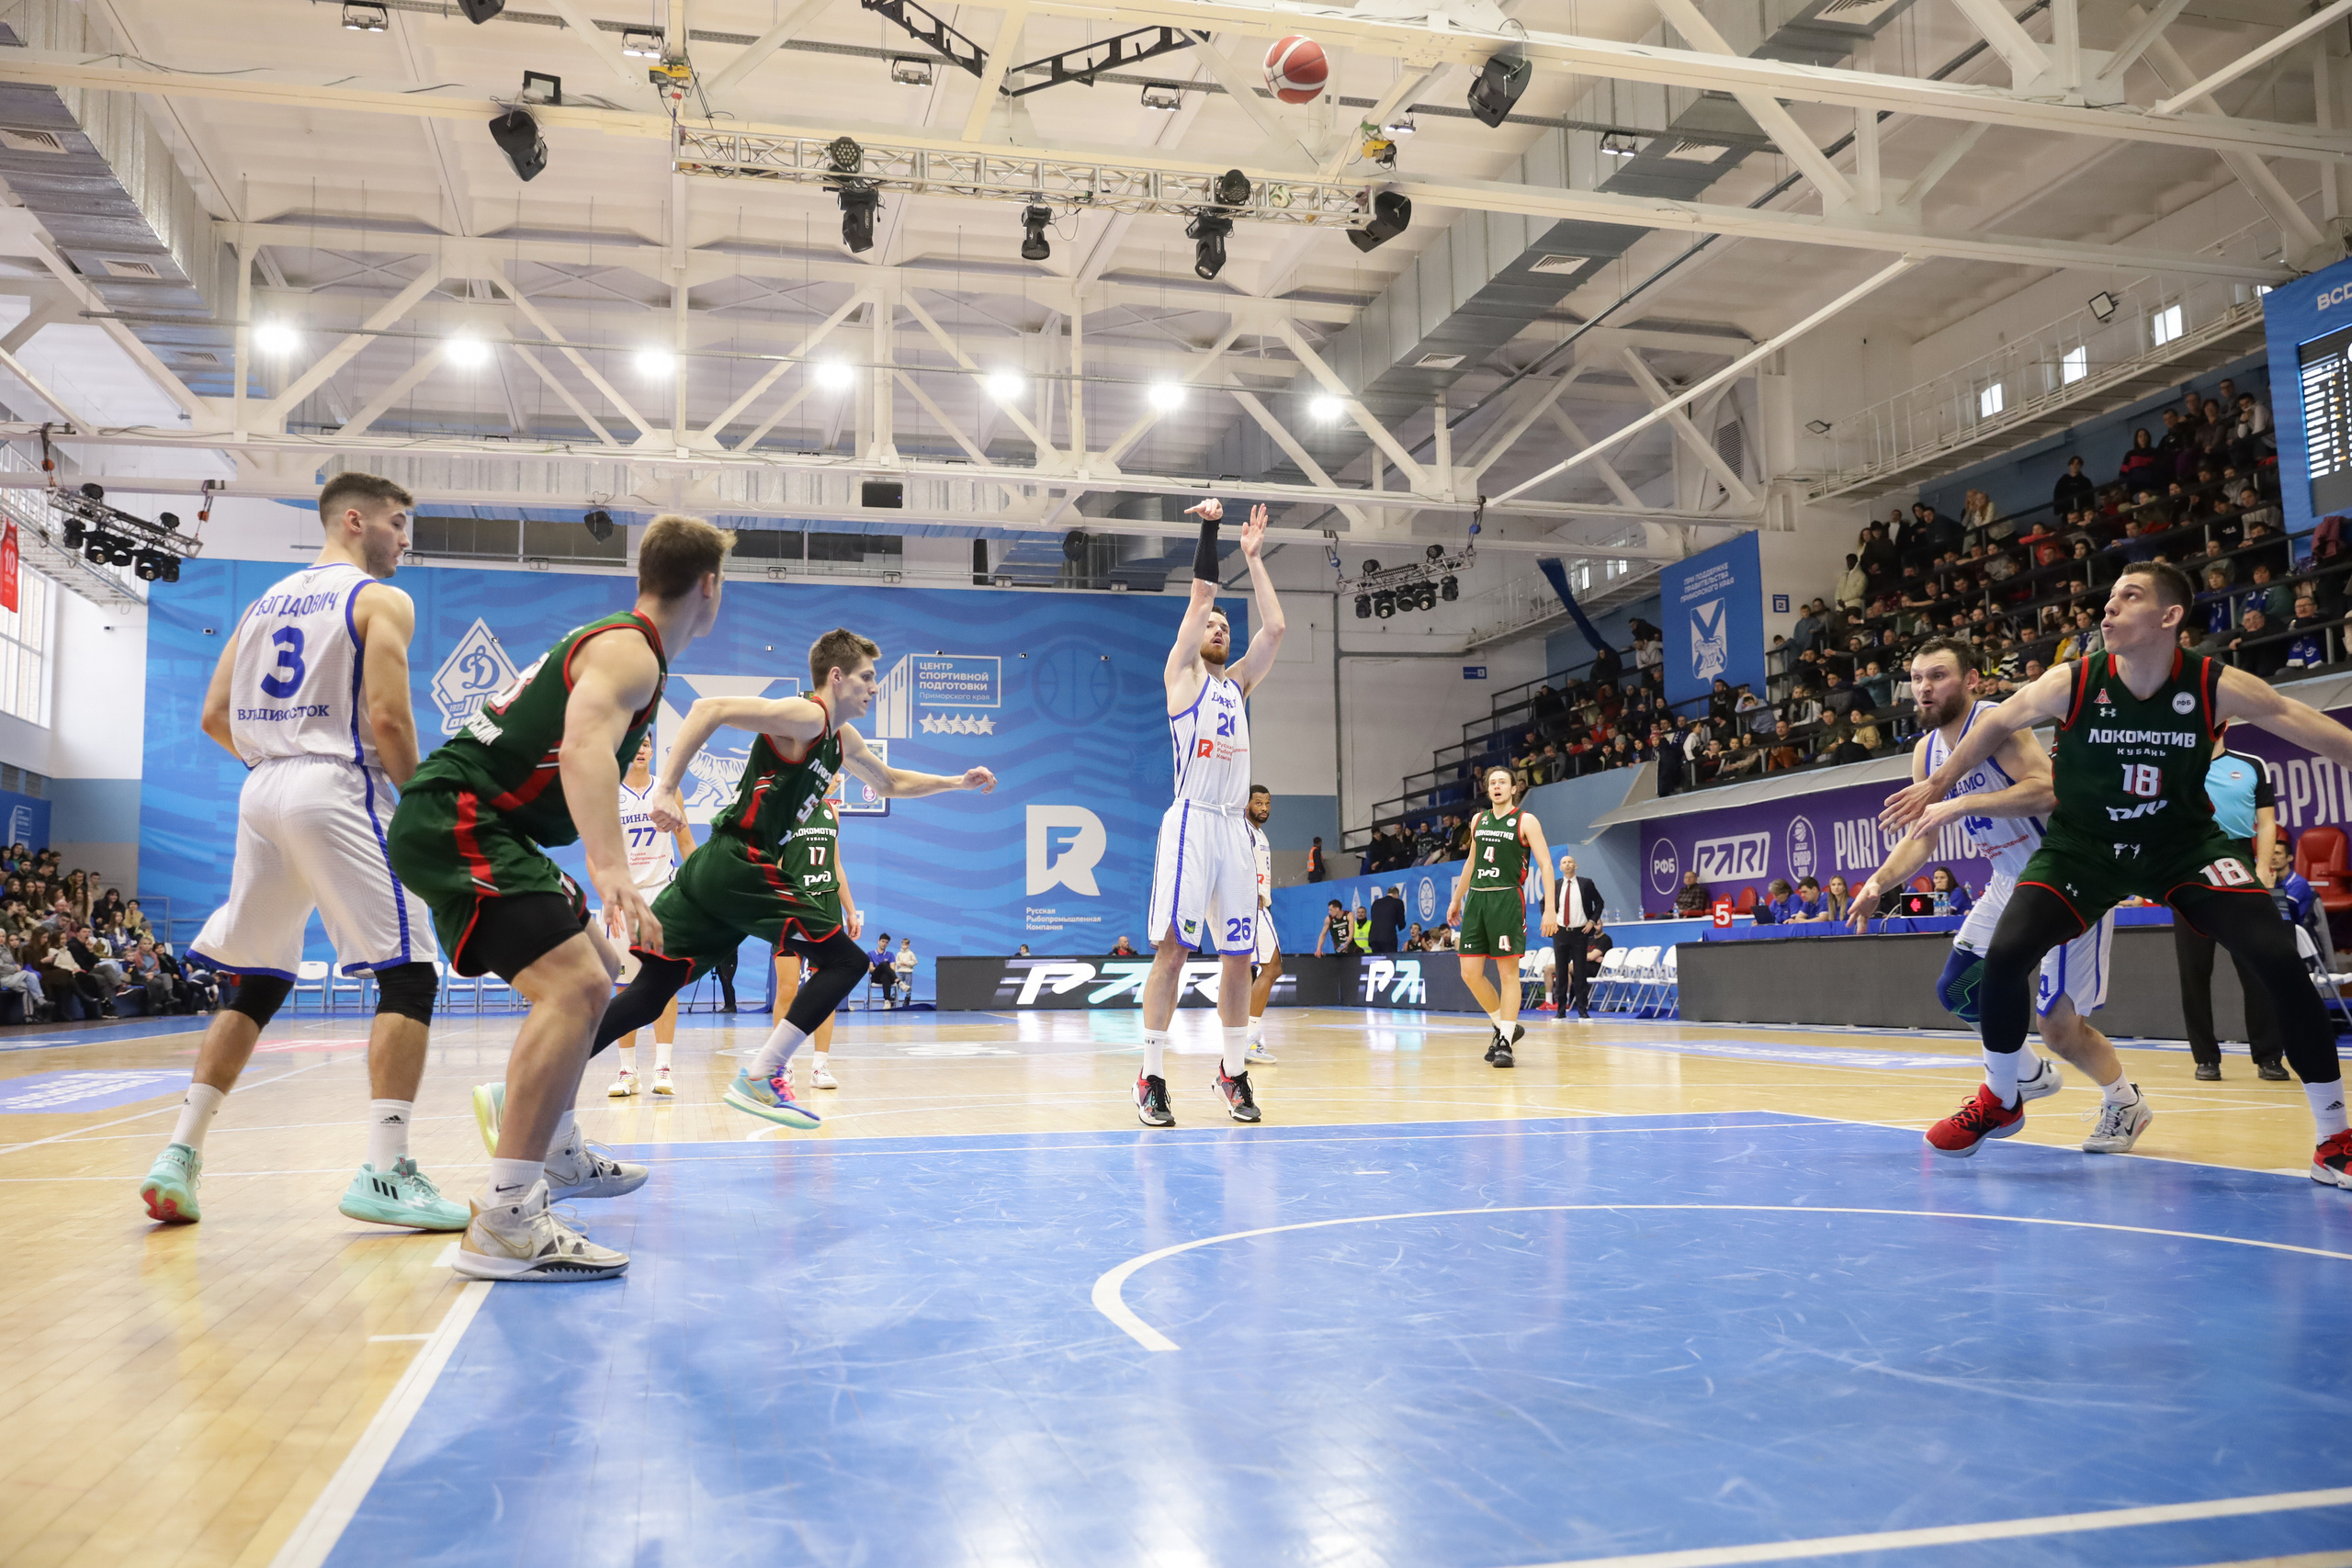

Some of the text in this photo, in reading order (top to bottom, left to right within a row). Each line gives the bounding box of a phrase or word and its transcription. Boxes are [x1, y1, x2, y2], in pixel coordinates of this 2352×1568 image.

[255, 592, 340, 617] БОГДАОВИЧ
[260, 626, 306, 699] 3
[920, 662, 953, 671] ЦЕНТР
[920, 671, 989, 682] СПОРТИВНОЙ
[920, 682, 988, 691] ПОДГОТОВКИ
[454, 692, 498, 716] 10
[920, 692, 970, 701] Приморского
[2088, 728, 2196, 748] ЛОКОМОТИВ
[2117, 749, 2165, 757] КУБАНЬ
[2121, 763, 2162, 798] 18
[628, 827, 657, 847] 77
[1475, 829, 1514, 840] ЛОКОМОТИВ
[1834, 818, 1880, 871] PARI
[808, 846, 827, 865] 17
[1483, 846, 1496, 863] 4
[1697, 838, 1766, 876] PARI
[1654, 858, 1675, 874] РФБ
[2199, 858, 2255, 886] 18
[1026, 916, 1102, 924] Рыбопромышленная
[1714, 904, 1730, 926] 5
[1227, 918, 1250, 942] 26
[1498, 935, 1511, 952] 4
[1016, 963, 1255, 1005] PAR
[1365, 960, 1426, 1004] PA
